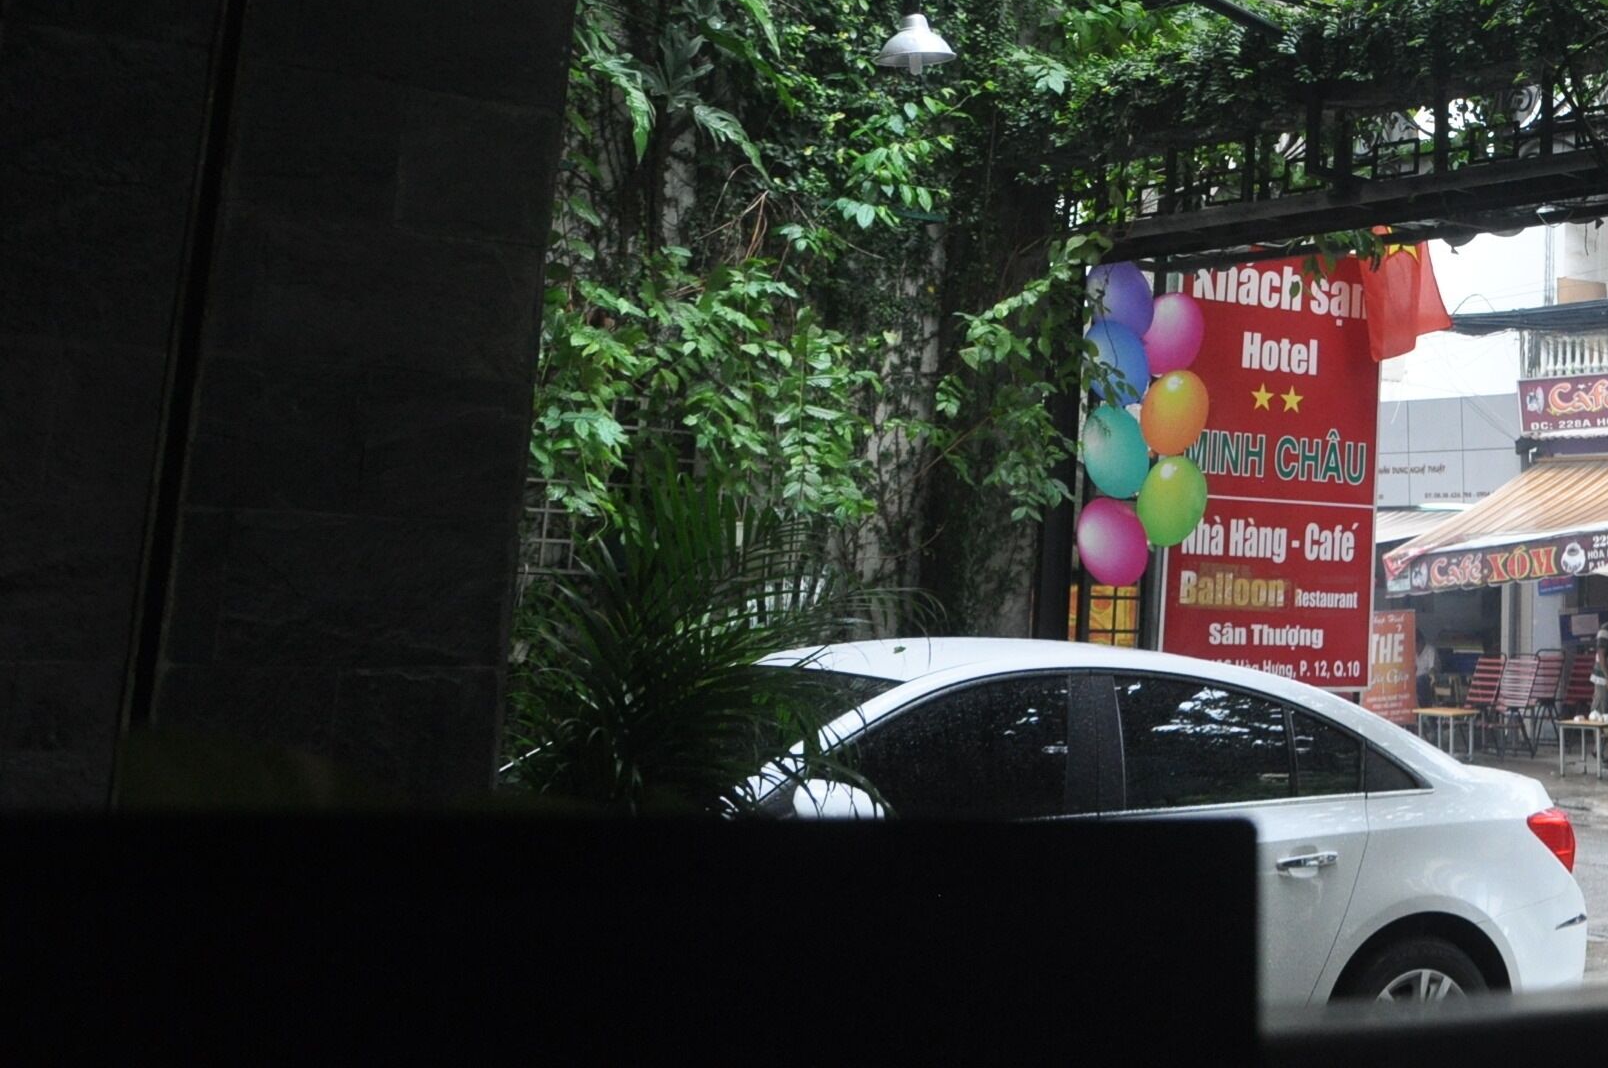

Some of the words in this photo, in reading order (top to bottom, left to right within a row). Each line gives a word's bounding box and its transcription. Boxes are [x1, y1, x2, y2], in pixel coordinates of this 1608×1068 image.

[1242, 331, 1319, 376] Hotel
[1558, 418, 1592, 430] 228A
[1275, 428, 1367, 485] CHÂU
[1229, 517, 1288, 564] Hàng
[1304, 522, 1359, 562] Café
[1430, 552, 1483, 586] Café
[1487, 545, 1558, 582] XÓM
[1179, 570, 1285, 608] Balloon
[1295, 588, 1359, 609] Restaurant
[1208, 622, 1247, 645] Sân
[1251, 623, 1324, 650] Thượng
[1300, 660, 1311, 677] P.
[1314, 660, 1331, 679] 12,
[1333, 660, 1361, 678] Q.10
